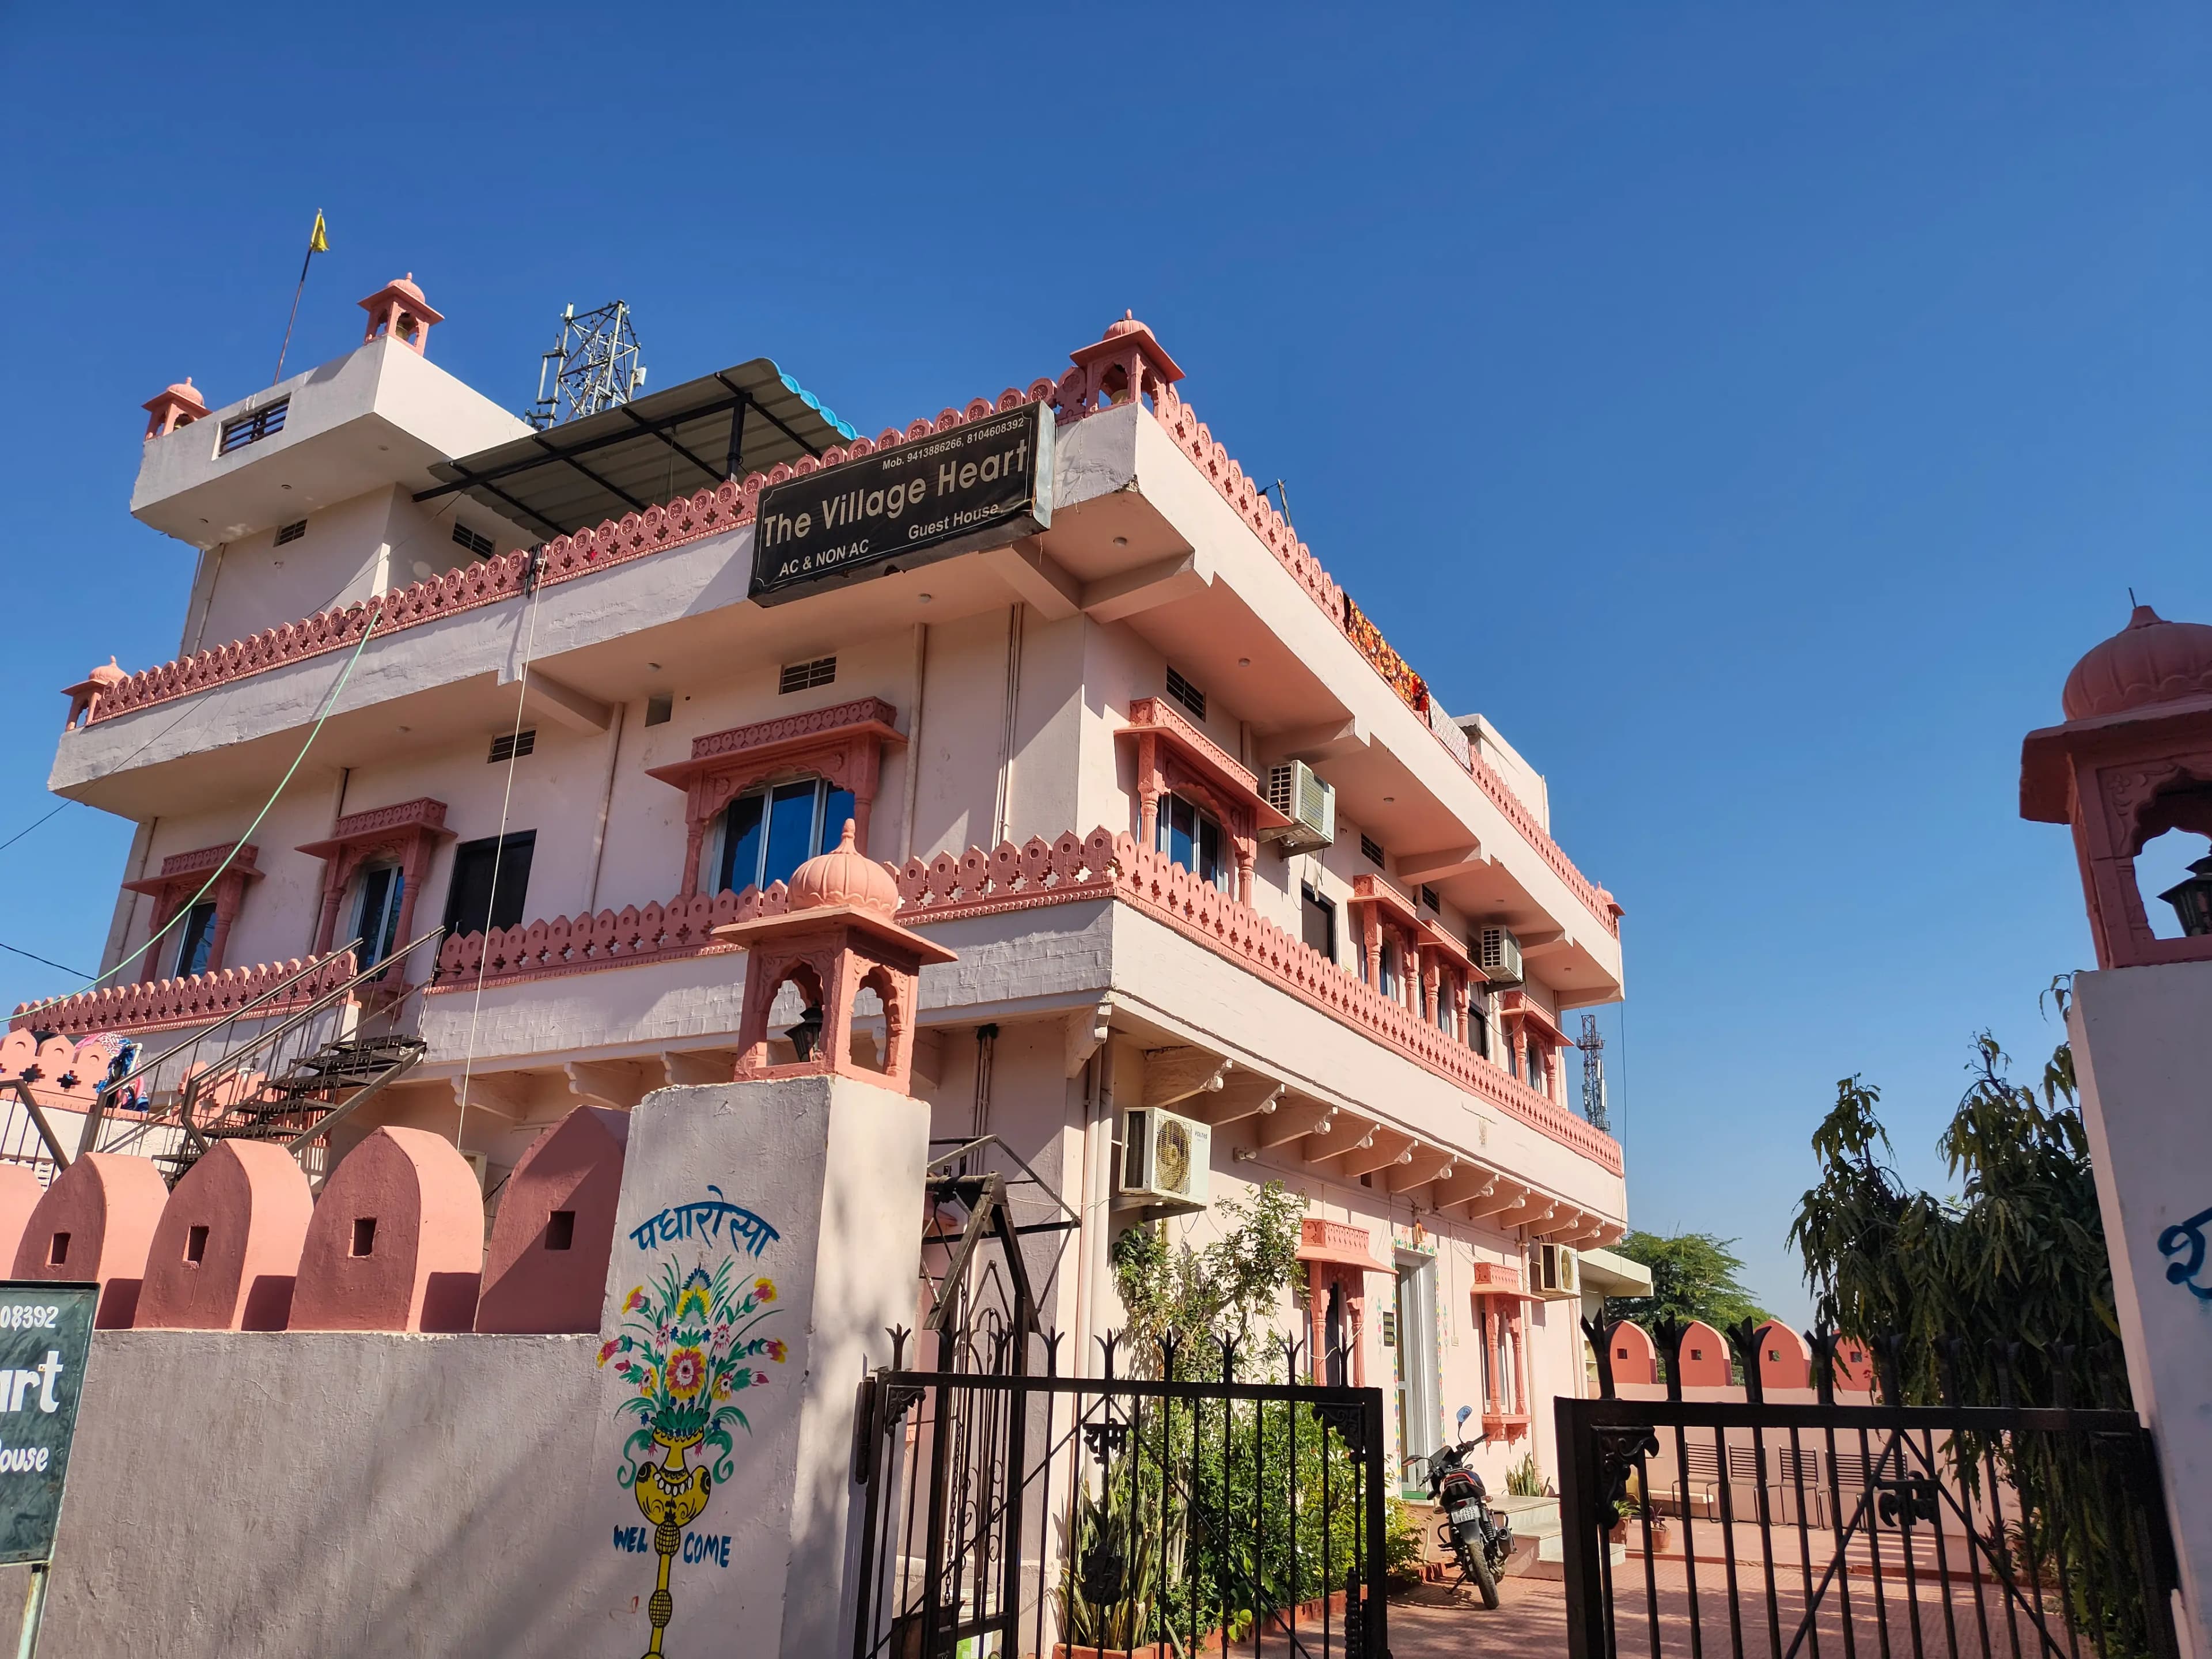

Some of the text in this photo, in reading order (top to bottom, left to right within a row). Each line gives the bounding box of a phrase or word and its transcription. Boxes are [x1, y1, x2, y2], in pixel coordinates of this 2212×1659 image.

[882, 418, 1024, 471] Mob. 9413886266, 8104608392
[764, 439, 1028, 547] The Village Heart
[908, 502, 998, 540] Guest House
[779, 539, 869, 577] AC & NON AC
[0, 1438, 49, 1472] ouse
[613, 1524, 732, 1568] WEL COME
